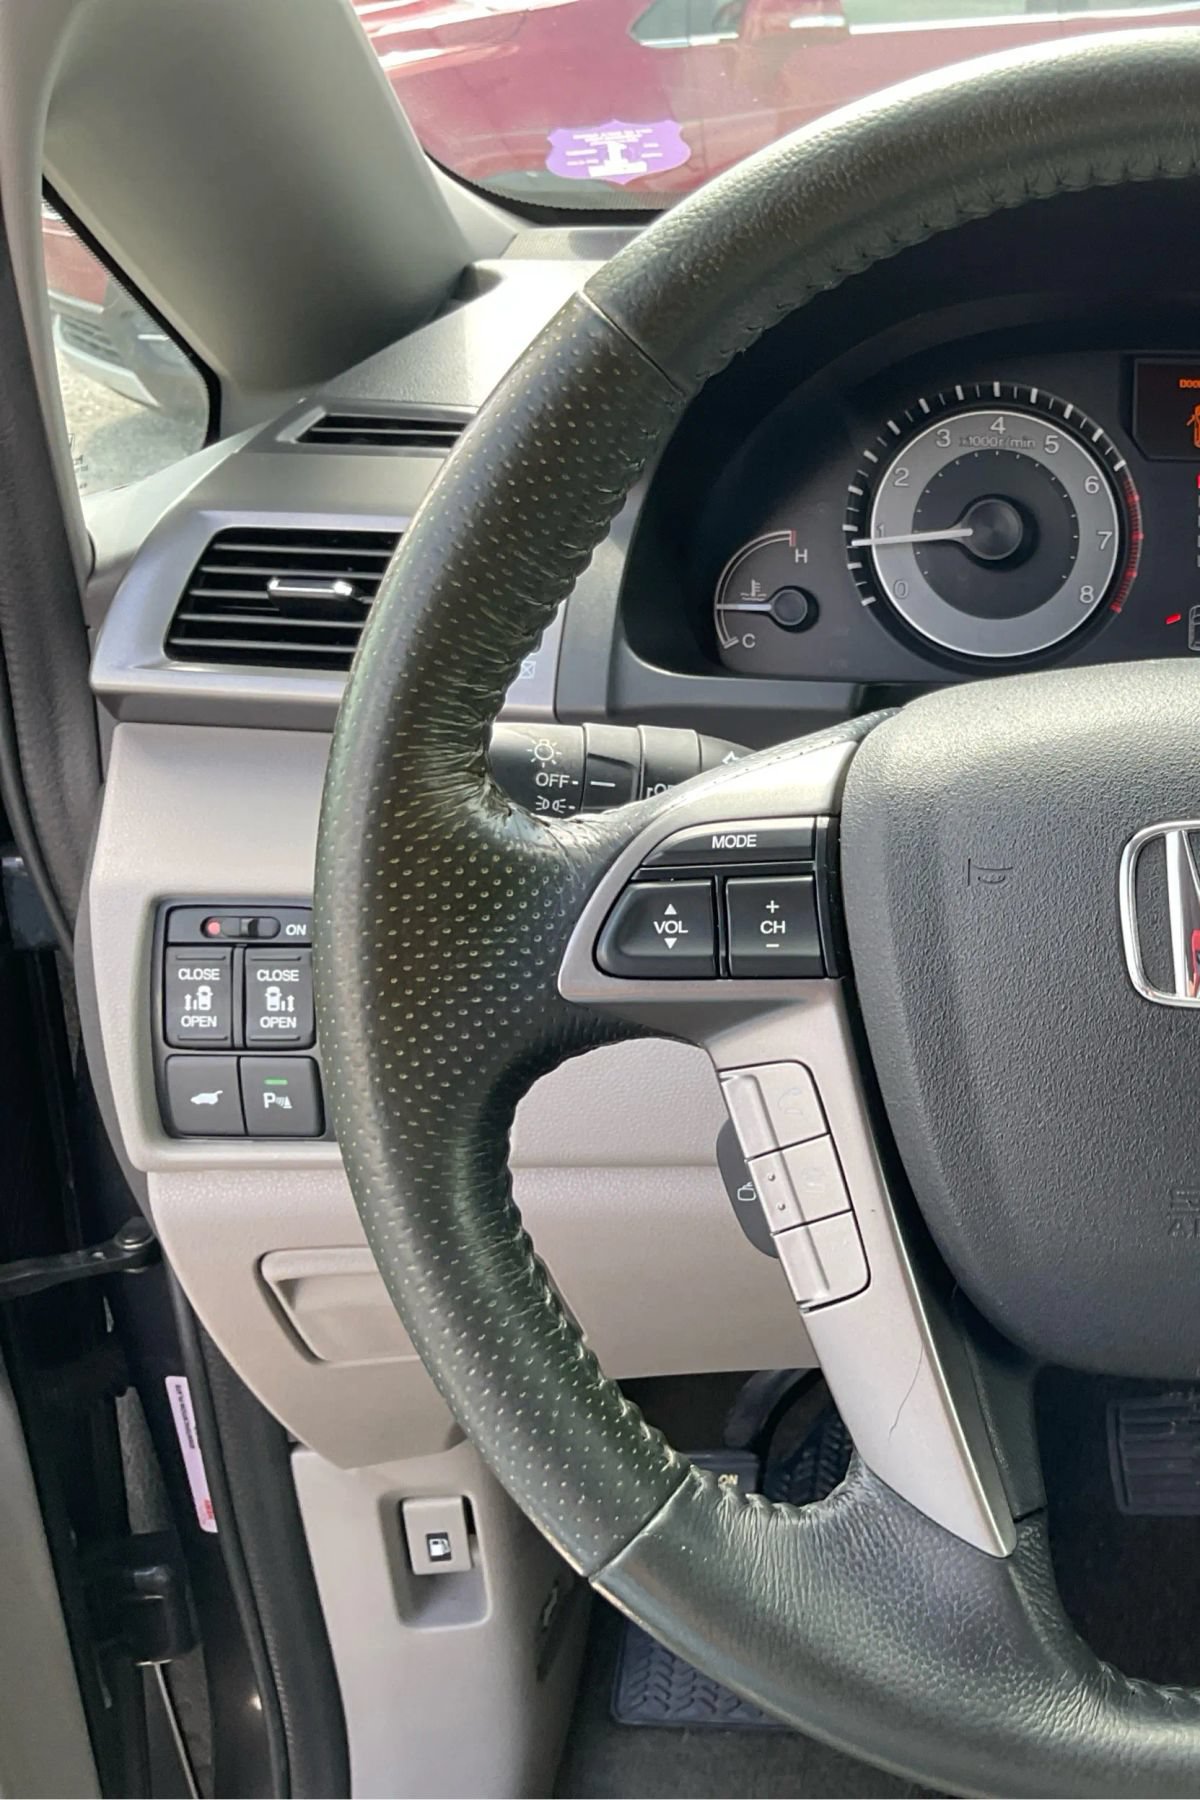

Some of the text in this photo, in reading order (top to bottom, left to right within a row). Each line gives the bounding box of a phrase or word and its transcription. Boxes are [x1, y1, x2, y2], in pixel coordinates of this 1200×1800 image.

[990, 416, 1006, 434] 4
[936, 428, 952, 448] 3
[1043, 434, 1061, 454] 5
[892, 467, 909, 487] 2
[1084, 476, 1100, 494] 6
[1097, 531, 1113, 550] 7
[795, 549, 808, 564] H
[893, 580, 909, 599] 0
[1079, 585, 1094, 603] 8
[742, 633, 756, 649] C
[535, 772, 570, 788] OFF
[711, 834, 757, 849] MODE
[285, 923, 307, 936] ON
[653, 920, 689, 934] VOL
[760, 920, 786, 934] CH
[178, 968, 221, 981] CLOSE
[256, 969, 299, 982] CLOSE
[180, 1015, 217, 1028] OPEN
[259, 1016, 297, 1029] OPEN
